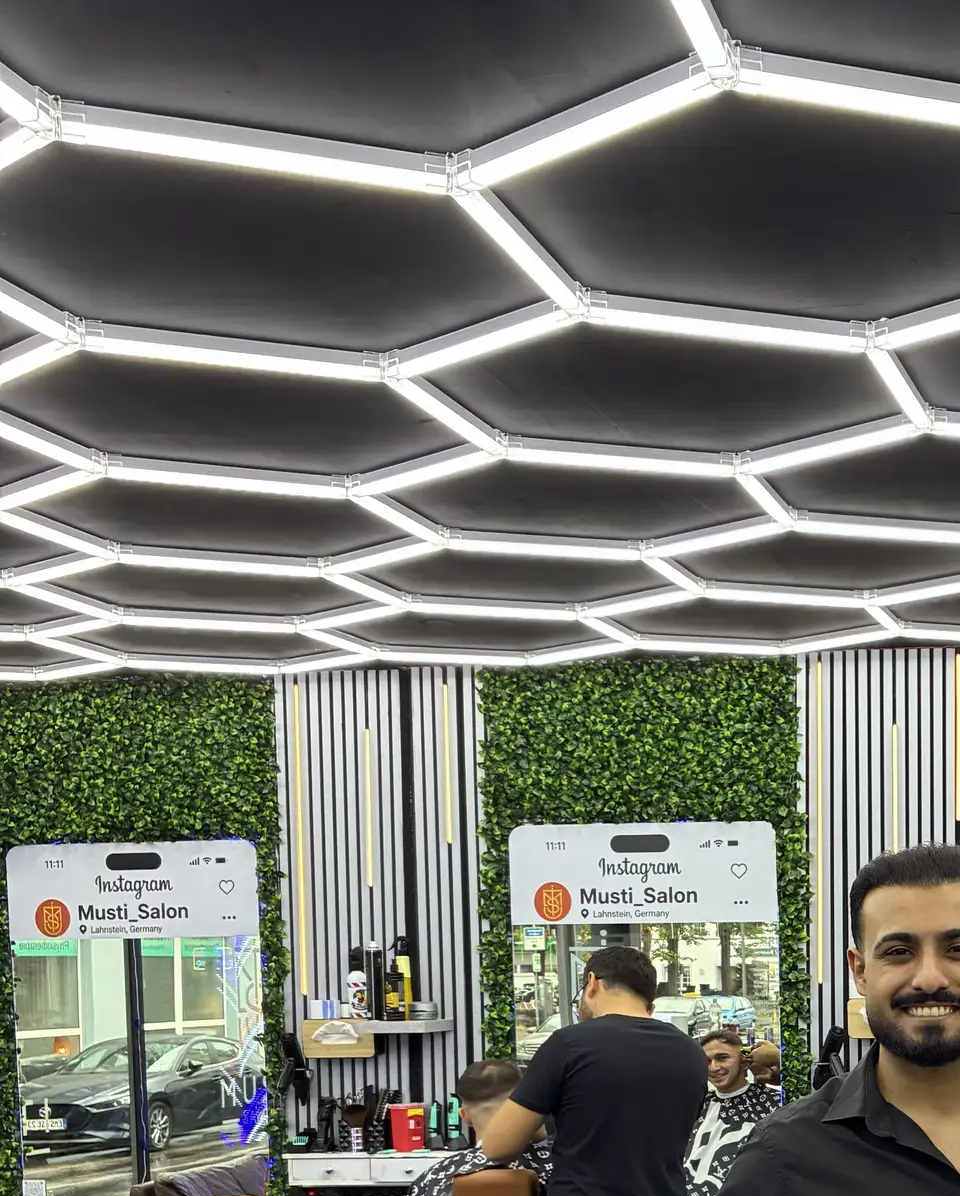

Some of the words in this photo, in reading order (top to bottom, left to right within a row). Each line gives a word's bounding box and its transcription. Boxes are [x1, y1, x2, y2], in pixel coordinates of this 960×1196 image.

[546, 841, 566, 851] 11:11
[45, 859, 64, 869] 11:11
[598, 857, 682, 883] Instagram
[94, 874, 174, 900] Instagram
[579, 886, 698, 907] Musti_Salon
[77, 902, 189, 923] Musti_Salon
[593, 909, 633, 919] Lahnstein,
[634, 909, 670, 919] Germany
[90, 925, 129, 935] Lahnstein,
[129, 924, 163, 935] Germany
